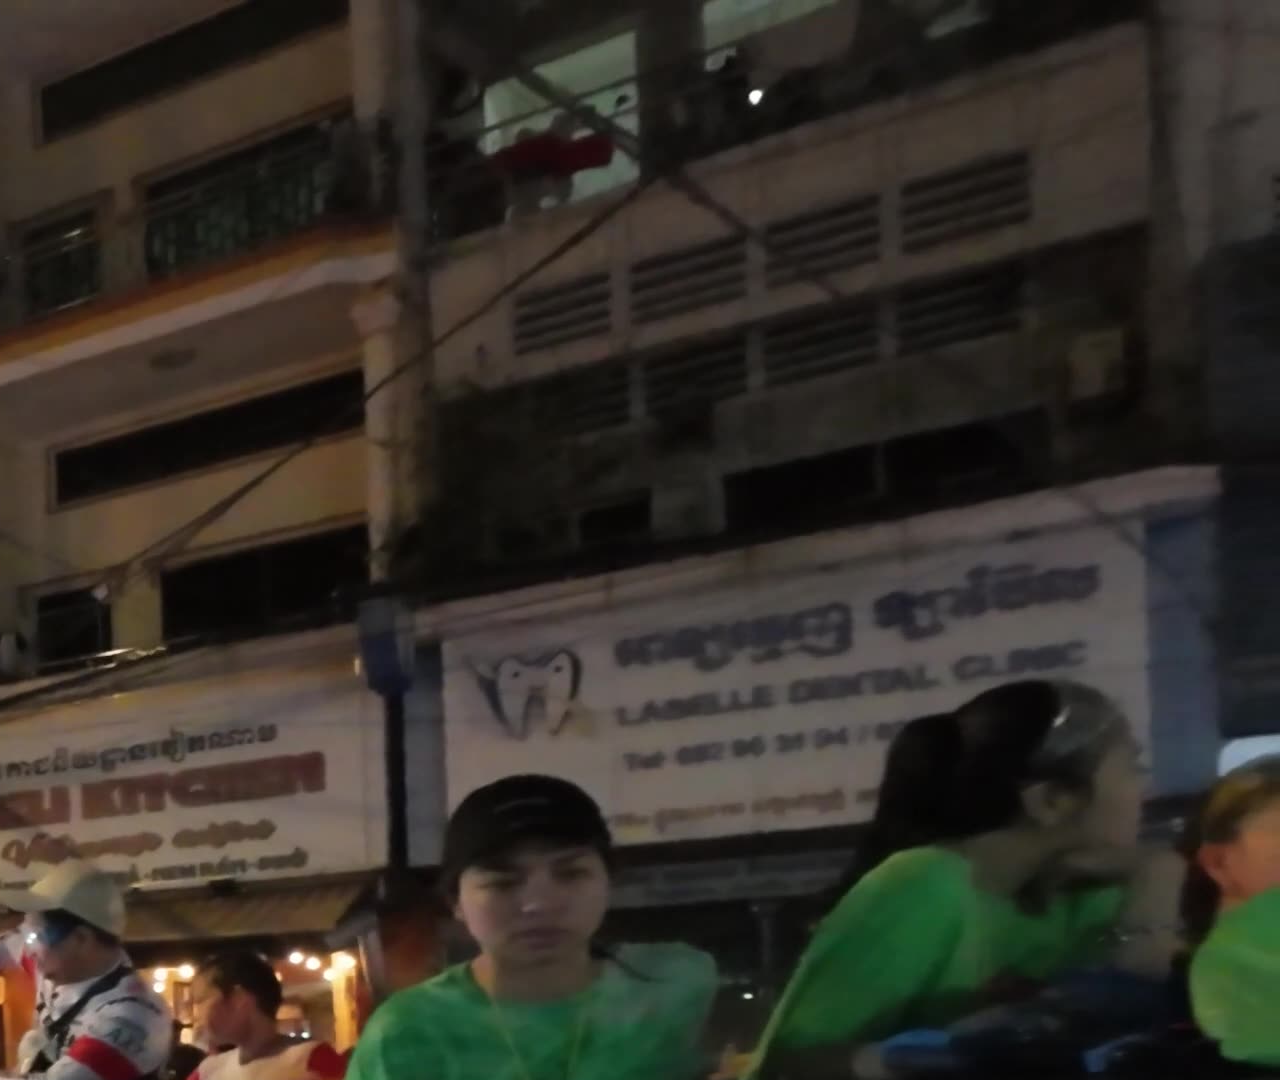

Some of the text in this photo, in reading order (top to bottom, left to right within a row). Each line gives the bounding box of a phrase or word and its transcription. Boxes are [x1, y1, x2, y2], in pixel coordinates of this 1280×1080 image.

[616, 640, 1087, 726] LABELLE DENTAL CLINIC
[80, 750, 327, 821] KITCHEN
